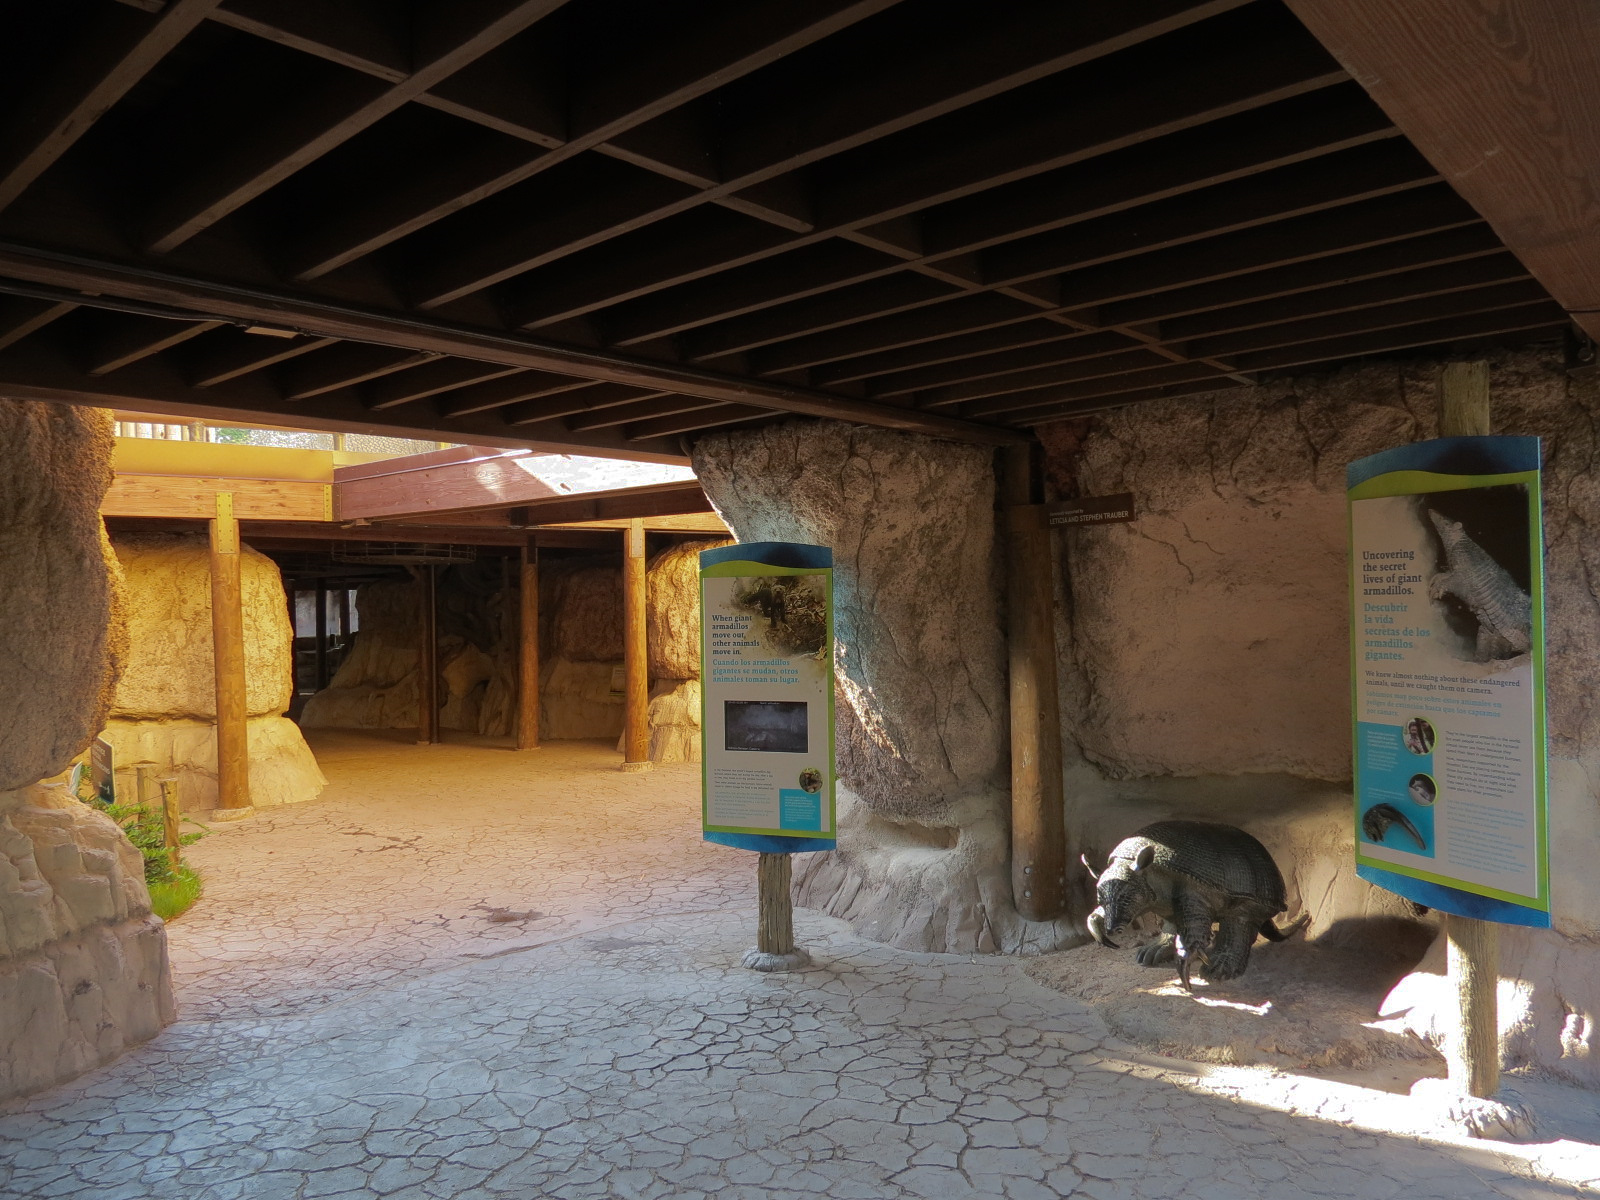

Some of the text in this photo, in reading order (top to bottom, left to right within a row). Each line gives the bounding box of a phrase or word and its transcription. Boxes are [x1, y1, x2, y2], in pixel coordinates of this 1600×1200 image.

[1103, 511, 1128, 519] TRAUBER
[1363, 549, 1414, 560] Uncovering
[1363, 563, 1406, 571] the secret
[1363, 573, 1422, 585] lives of giant
[1364, 586, 1414, 595] armadillos.
[1364, 602, 1408, 612] Descubrir
[1365, 614, 1394, 623] la vida
[1365, 627, 1431, 636] secretas de los
[1365, 639, 1413, 648] armadillos
[1365, 649, 1405, 661] gigantes.
[779, 676, 799, 684] lugar.
[1376, 670, 1391, 678] knew
[1414, 674, 1439, 683] nothing
[1460, 676, 1478, 684] these
[1479, 678, 1520, 687] endangered
[1416, 683, 1437, 691] caught
